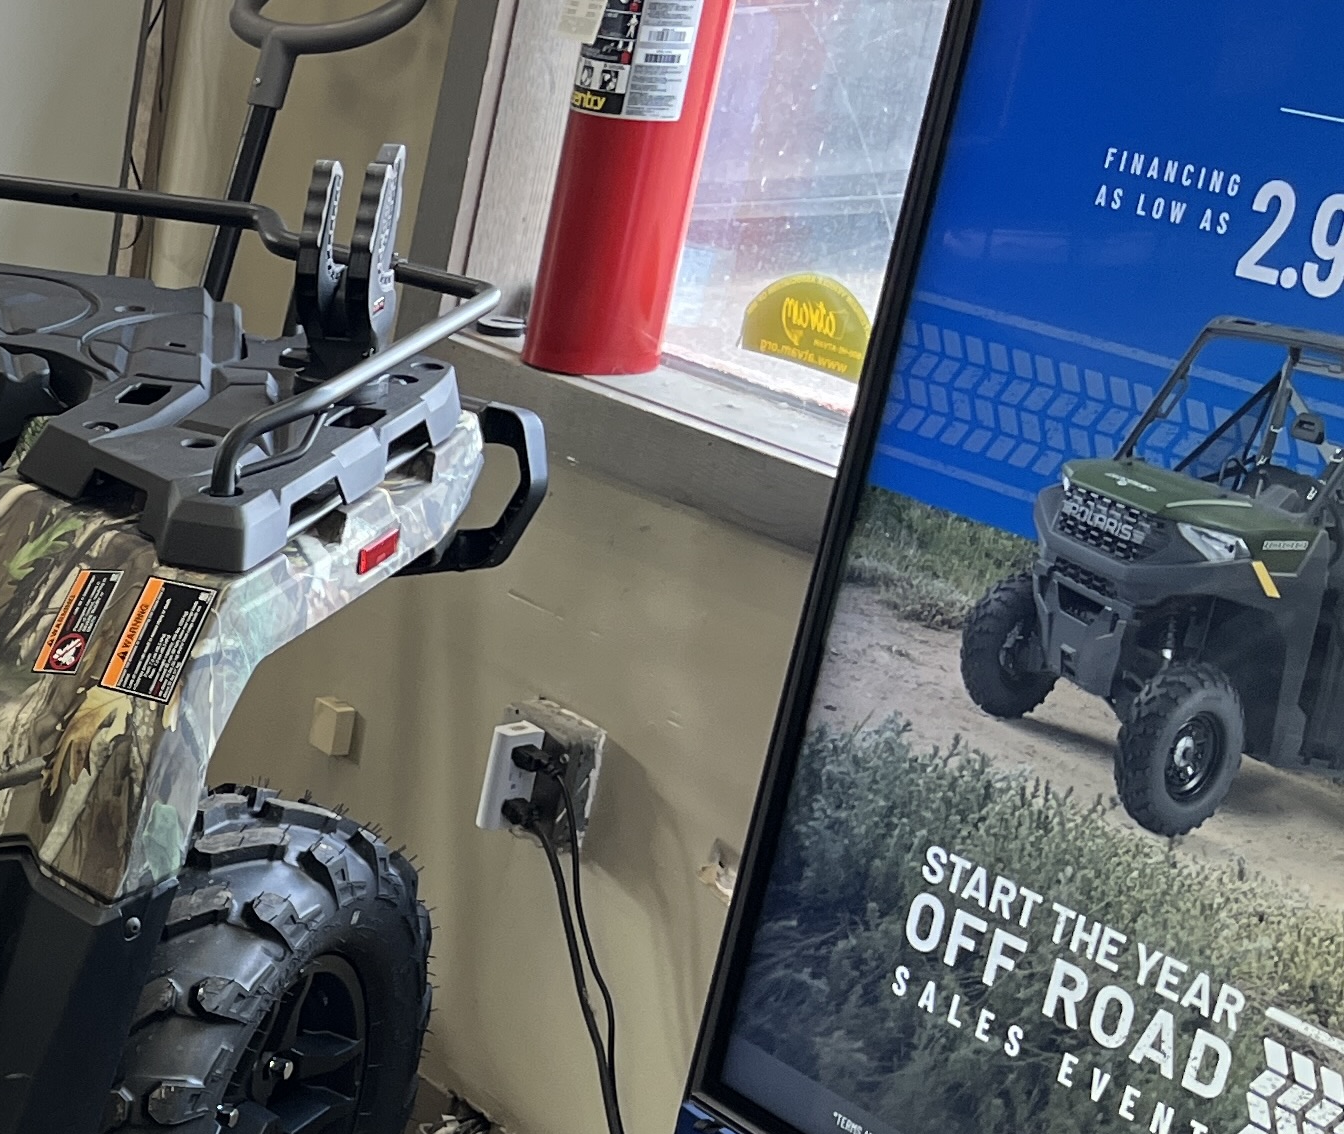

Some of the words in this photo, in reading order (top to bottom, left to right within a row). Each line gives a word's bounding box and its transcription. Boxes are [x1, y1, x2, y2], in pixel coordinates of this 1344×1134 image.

[1103, 147, 1242, 197] FINANCING
[1094, 184, 1124, 210] AS
[1136, 193, 1187, 225] LOW
[1199, 208, 1230, 235] AS
[1069, 501, 1134, 543] POLARIS
[121, 603, 150, 650] WARNING
[922, 845, 1043, 928] START
[1052, 902, 1127, 972] THE
[1137, 942, 1246, 1031] YEAR
[891, 965, 1024, 1057] SALES
[905, 892, 1028, 987] OFF
[1041, 957, 1232, 1099] ROAD
